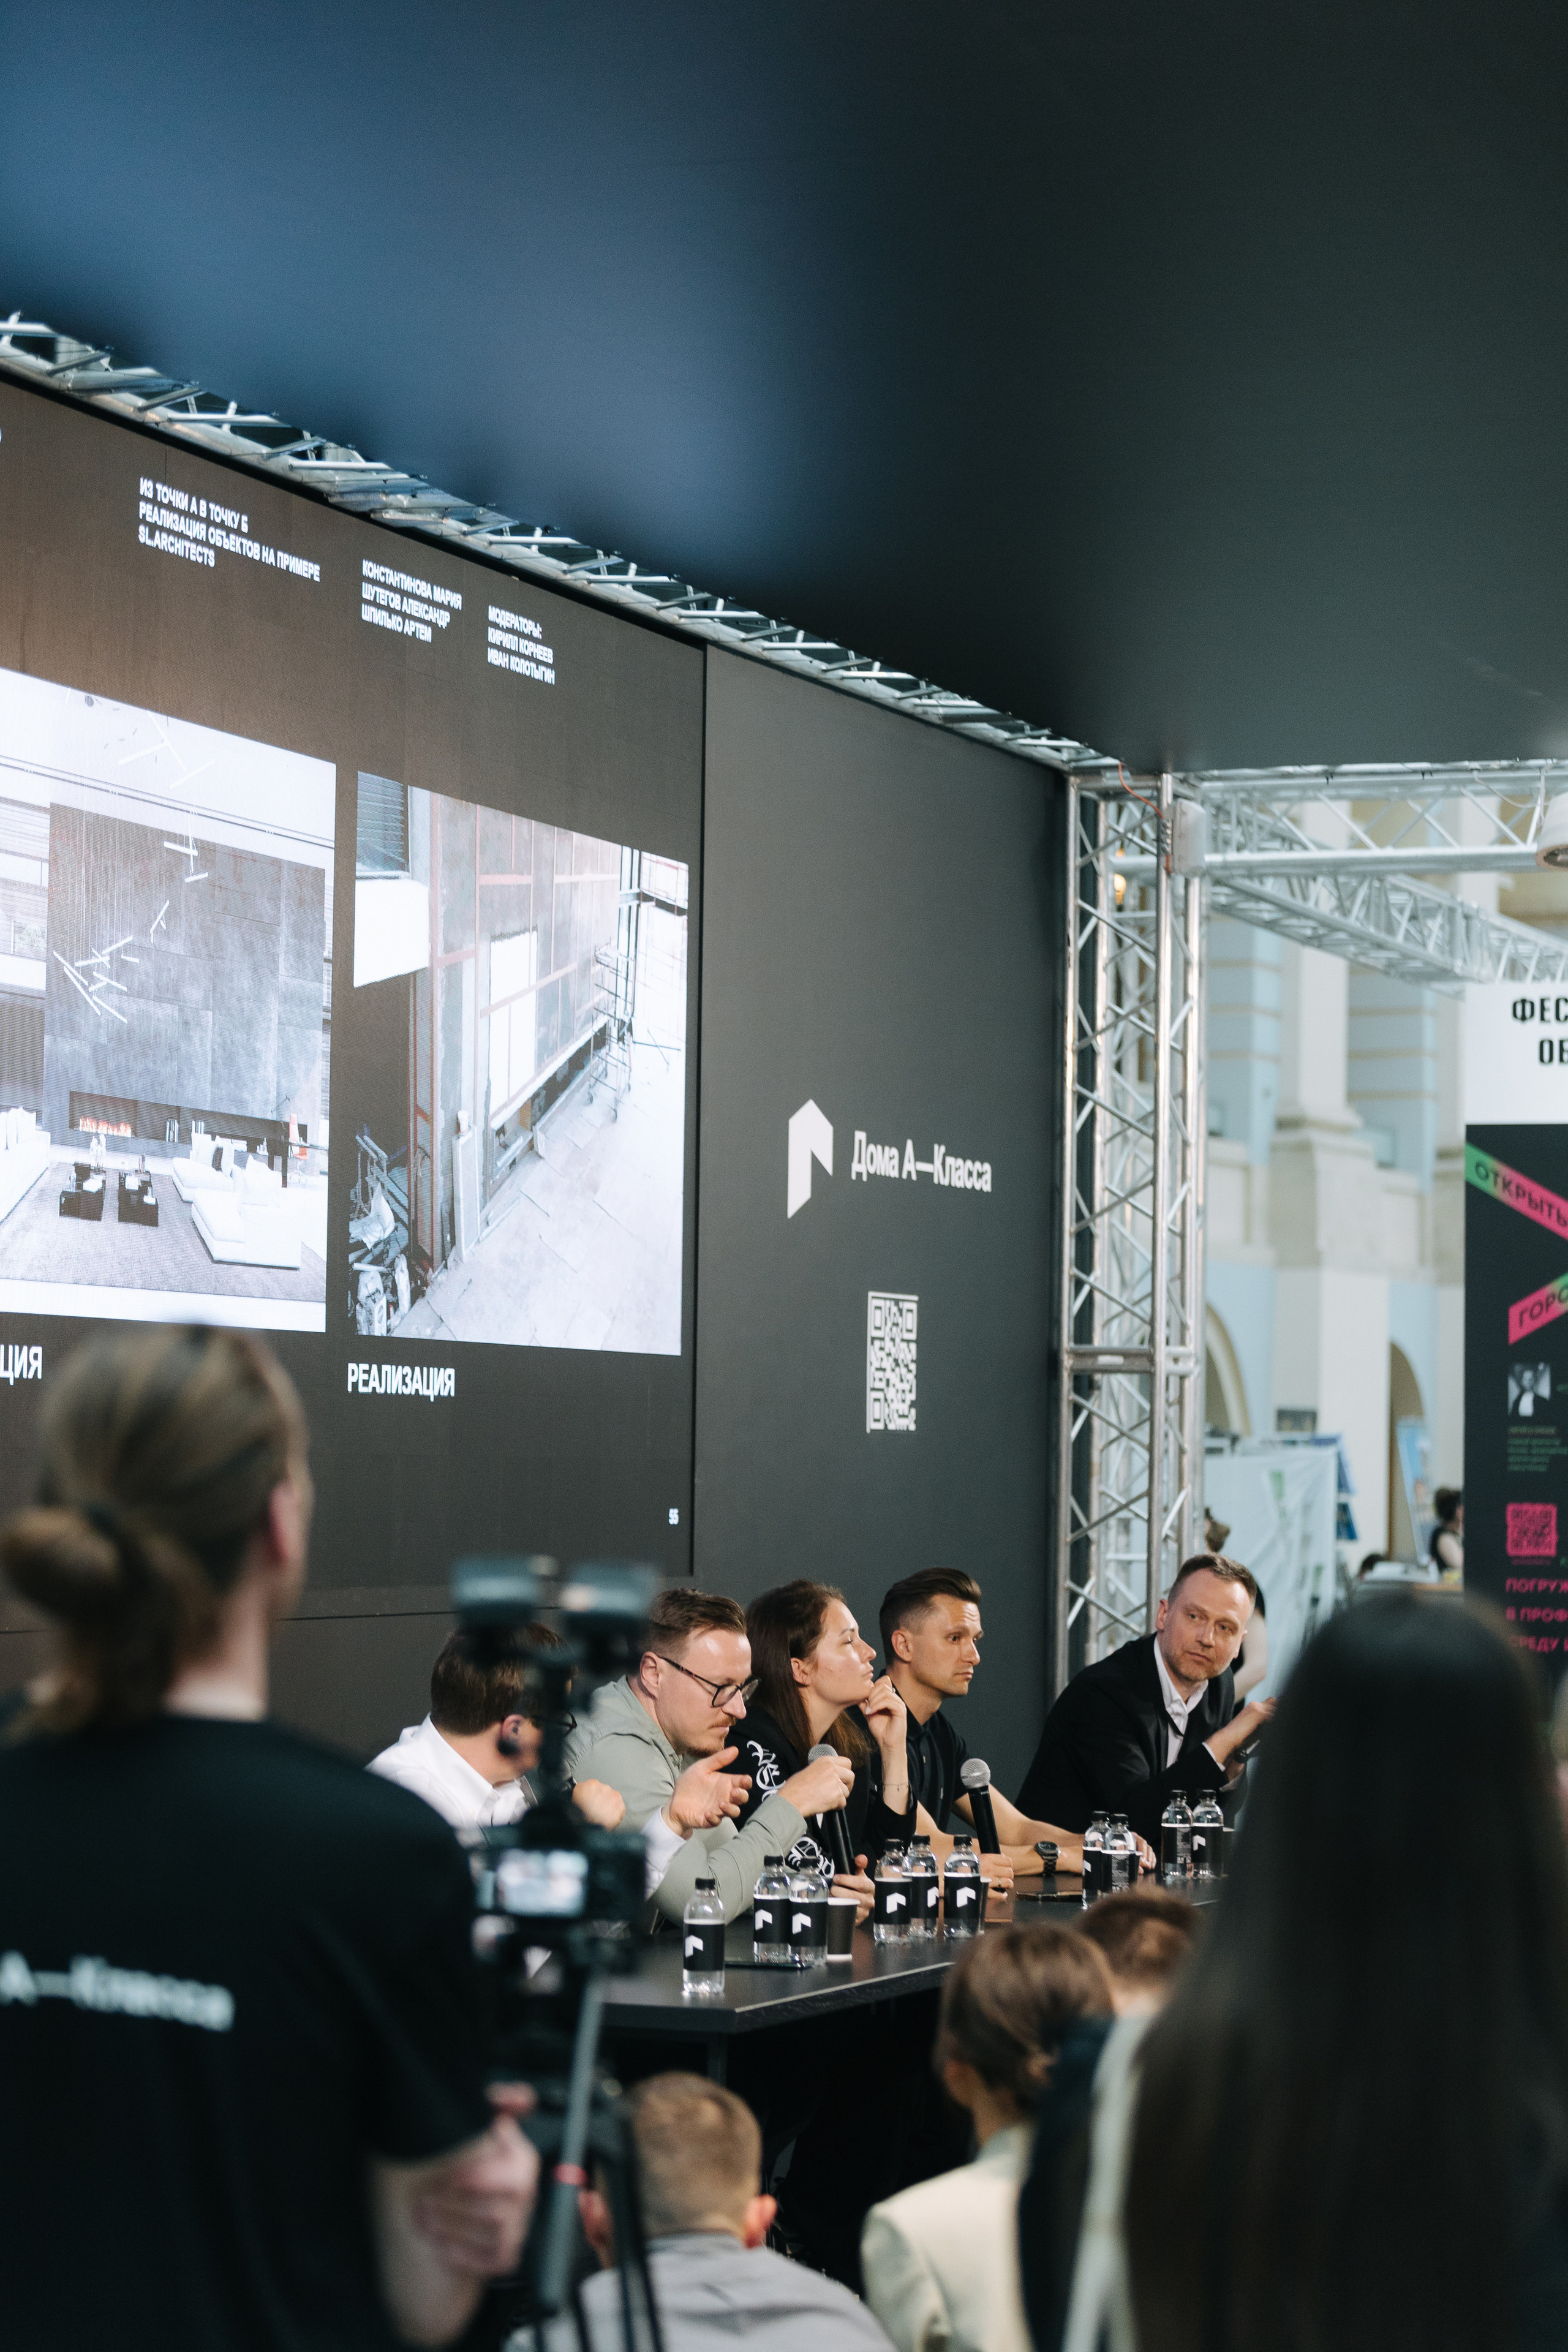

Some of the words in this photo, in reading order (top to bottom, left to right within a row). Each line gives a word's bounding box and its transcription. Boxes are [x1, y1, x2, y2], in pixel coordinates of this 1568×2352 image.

[140, 477, 153, 499] ИЗ
[156, 482, 189, 511] ТОЧКИ
[190, 496, 198, 515] А
[199, 499, 207, 518] В
[209, 502, 239, 529] ТОЧКУ
[241, 514, 249, 533] Б
[138, 524, 215, 567] SL.ARCHITECTS
[139, 500, 206, 541] РЕАЛИЗАЦИЯ
[208, 526, 260, 561] ОБЪЕКТОВ
[262, 545, 276, 567] НА
[277, 550, 320, 582] ПРИМЕРЕ
[361, 581, 401, 611] ШУТЕГОВ
[402, 597, 451, 630] АЛЕКСАНДР
[362, 559, 432, 600] КОНСТАНТИНОВА
[433, 584, 462, 611] МАРИЯ
[361, 603, 403, 633] ШПИЛЬКО
[403, 618, 432, 643] АРТЕМ
[488, 604, 542, 640] МОДЕРАТОРЫ:
[487, 646, 509, 669] ИВАН
[510, 655, 555, 685] КОЛОТЫГИН
[488, 626, 519, 652] КИРИЛЛ
[519, 637, 554, 665] КОРНЕЕВ
[1512, 997, 1568, 1023] ФЕС
[851, 1130, 899, 1182] Дома
[347, 1362, 455, 1403] РЕАЛИЗАЦИЯ
